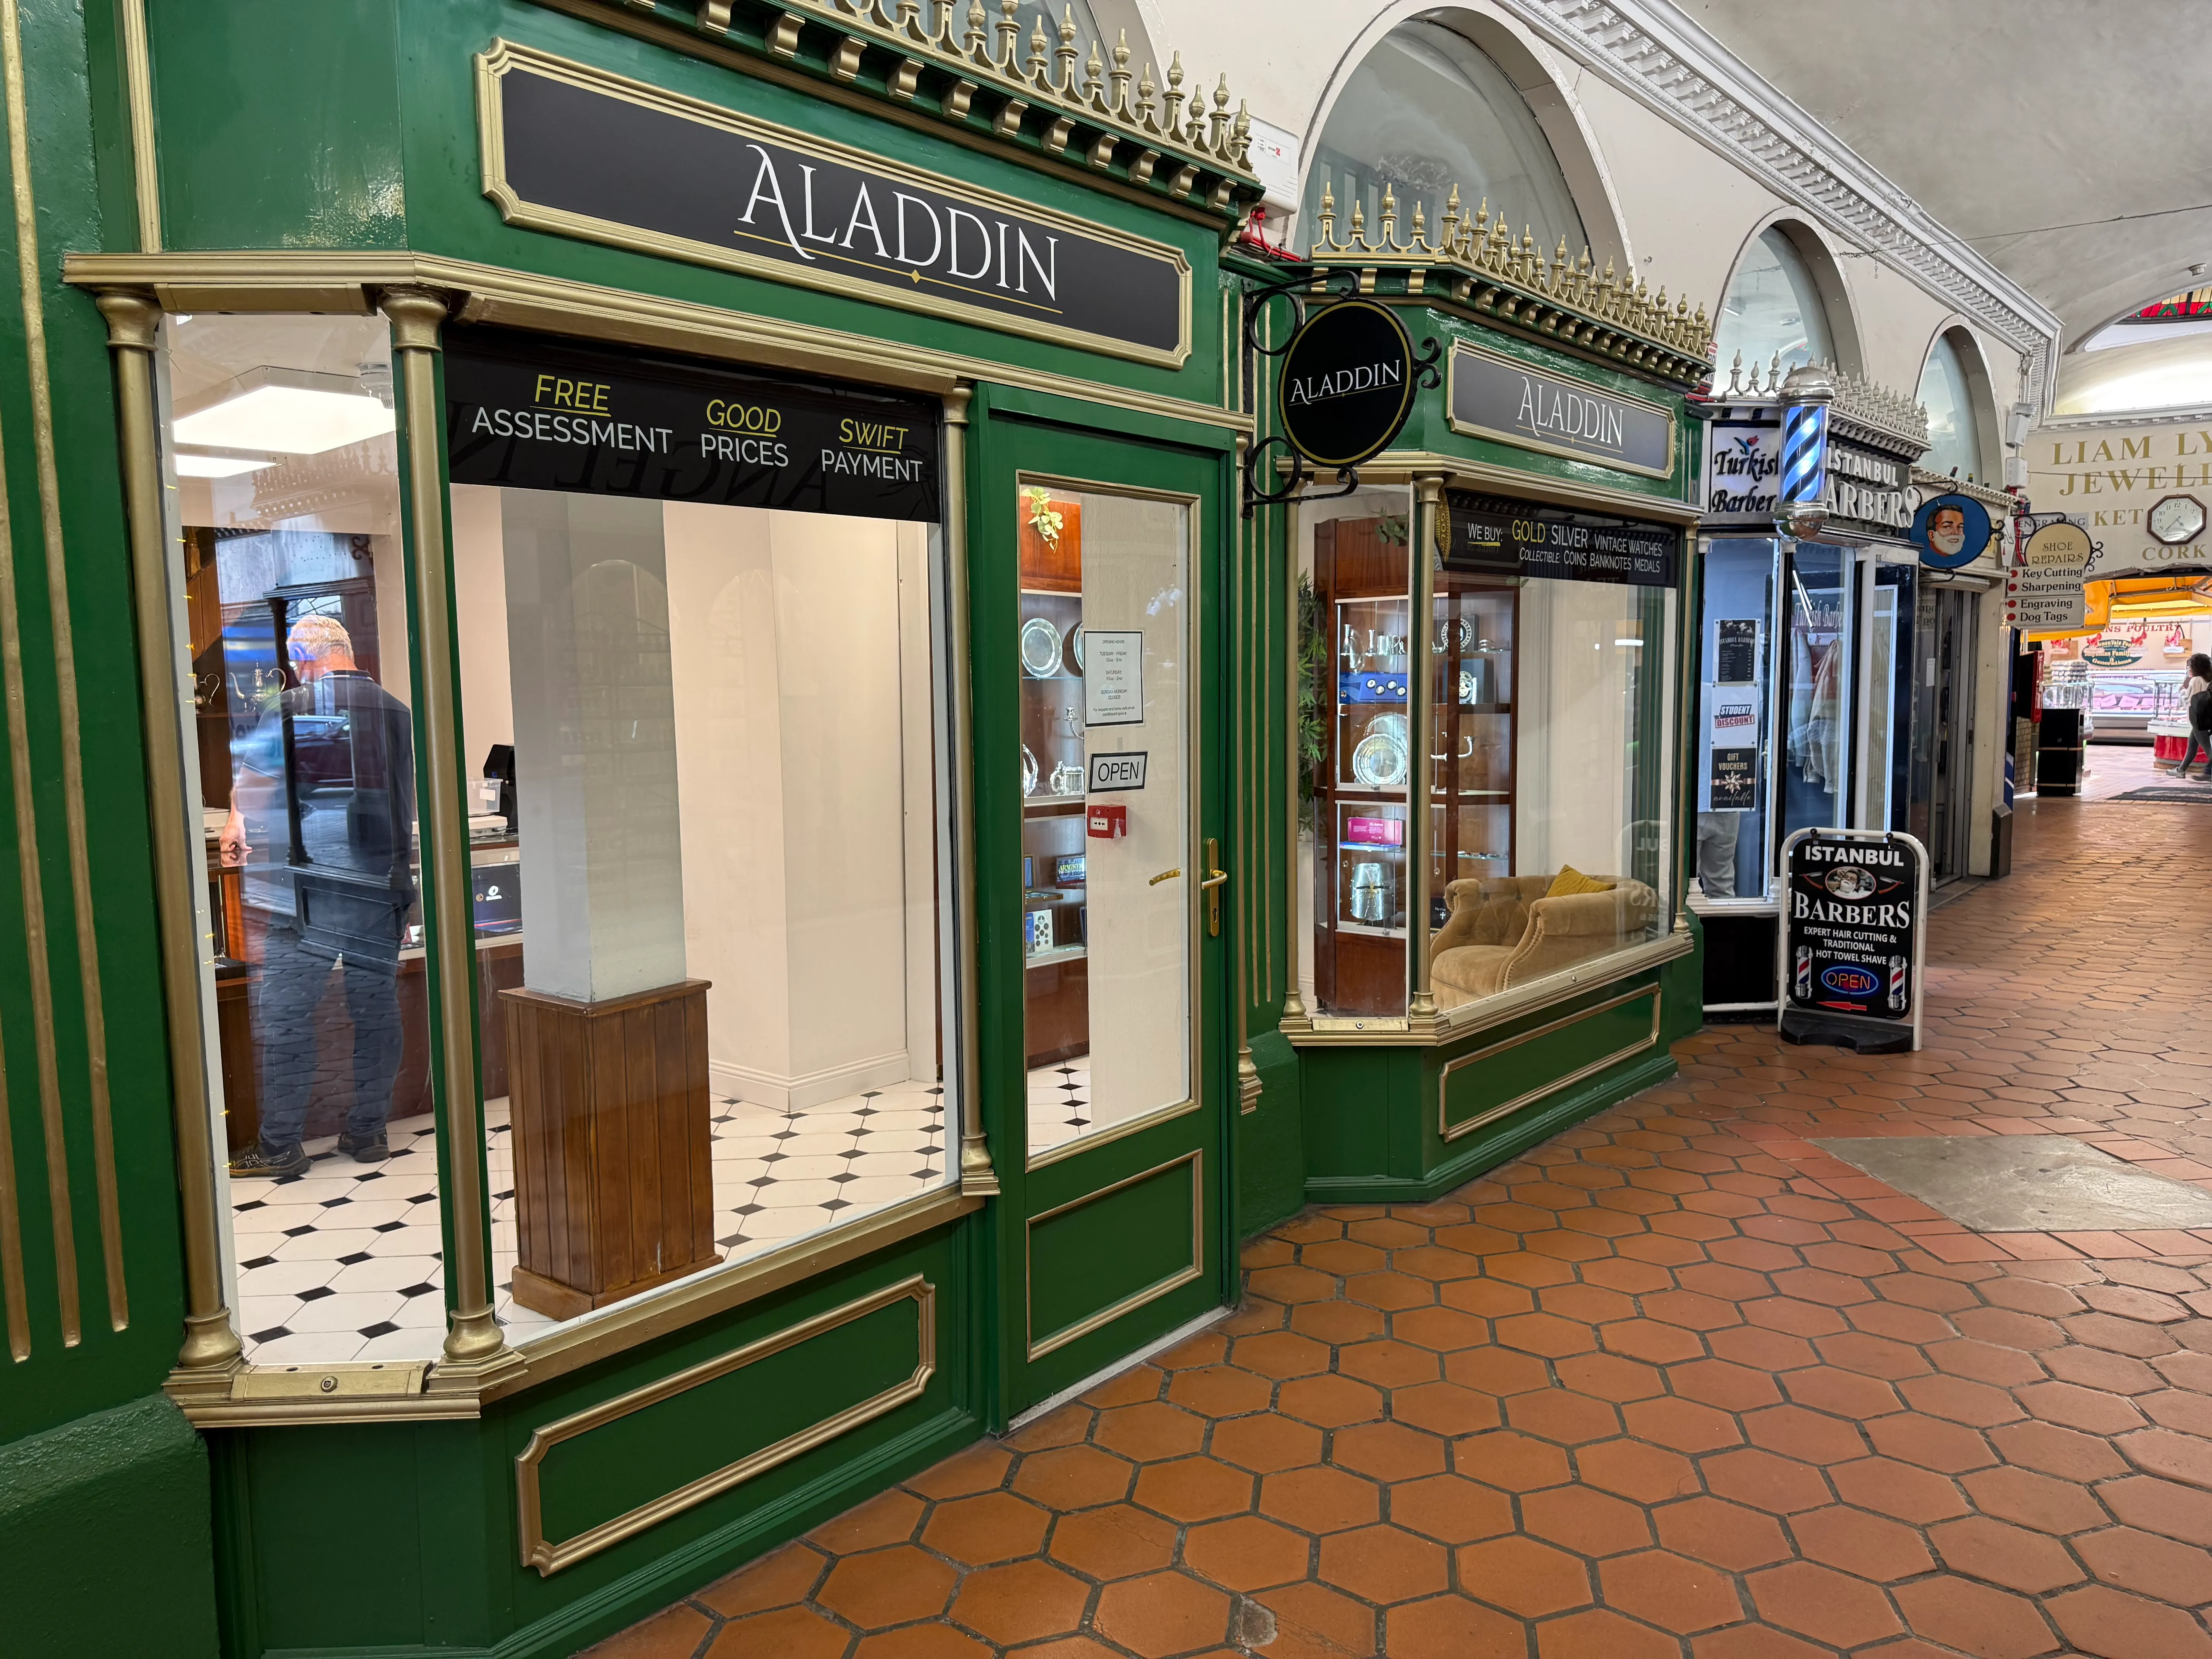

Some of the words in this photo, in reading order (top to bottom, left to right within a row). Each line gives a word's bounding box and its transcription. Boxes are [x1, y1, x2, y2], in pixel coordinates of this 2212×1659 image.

[737, 144, 1059, 301] ALADDIN
[1291, 359, 1401, 404] ALADDIN
[534, 373, 611, 412] FREE
[706, 398, 781, 433] GOOD
[1517, 376, 1623, 447] ALADDIN
[472, 406, 673, 454] ASSESSMENT
[838, 417, 909, 450] SWIFT
[701, 433, 790, 468] PRICES
[2051, 435, 2154, 465] LIAM
[821, 448, 924, 483] PAYMENT
[1826, 447, 1898, 487] ISTANBUL
[1712, 485, 1777, 512] Barber
[1824, 474, 1914, 529] ARBERS
[2093, 508, 2144, 527] KET
[1468, 522, 1482, 540] WE
[1484, 526, 1503, 543] BUY:
[1512, 519, 1546, 543] GOLD
[1551, 525, 1588, 548] SILVER
[1594, 534, 1627, 553] VINTAGE
[1628, 539, 1662, 557] WATCHES
[2042, 542, 2073, 552] SHOE
[1520, 547, 1561, 564] COLLECTIBLE:
[1563, 550, 1587, 567] COINS
[1590, 553, 1632, 570] BANKNOTES
[1634, 558, 1660, 573] MEDALS
[2032, 553, 2083, 565] REPAIRS
[2142, 544, 2207, 561] CORK
[2022, 568, 2042, 579] Key
[2044, 568, 2083, 578] Cutting
[2021, 582, 2081, 592] Sharpening
[2021, 599, 2073, 610] Engraving
[2020, 612, 2041, 622] Dog
[2044, 611, 2068, 621] Tags
[1717, 716, 1753, 726] DISCOUNT
[1720, 706, 1751, 715] STUDENT
[1718, 762, 1748, 771] VOUCHERS
[1727, 753, 1739, 761] GIFT
[1097, 761, 1139, 782] OPEN
[1713, 790, 1752, 806] available
[1805, 845, 1904, 867] ISTANBUL
[1794, 891, 1910, 929] BARBERS
[1804, 926, 1831, 937] EXPERT
[1832, 928, 1852, 939] HAIR
[1853, 931, 1888, 943] CUTTING
[1889, 934, 1897, 944] &
[1823, 938, 1875, 952] TRADITIONAL
[1815, 949, 1832, 959] HOT
[1833, 951, 1860, 962] TOWEL
[1861, 954, 1887, 965] SHAVE
[1826, 972, 1870, 990] OPEN
